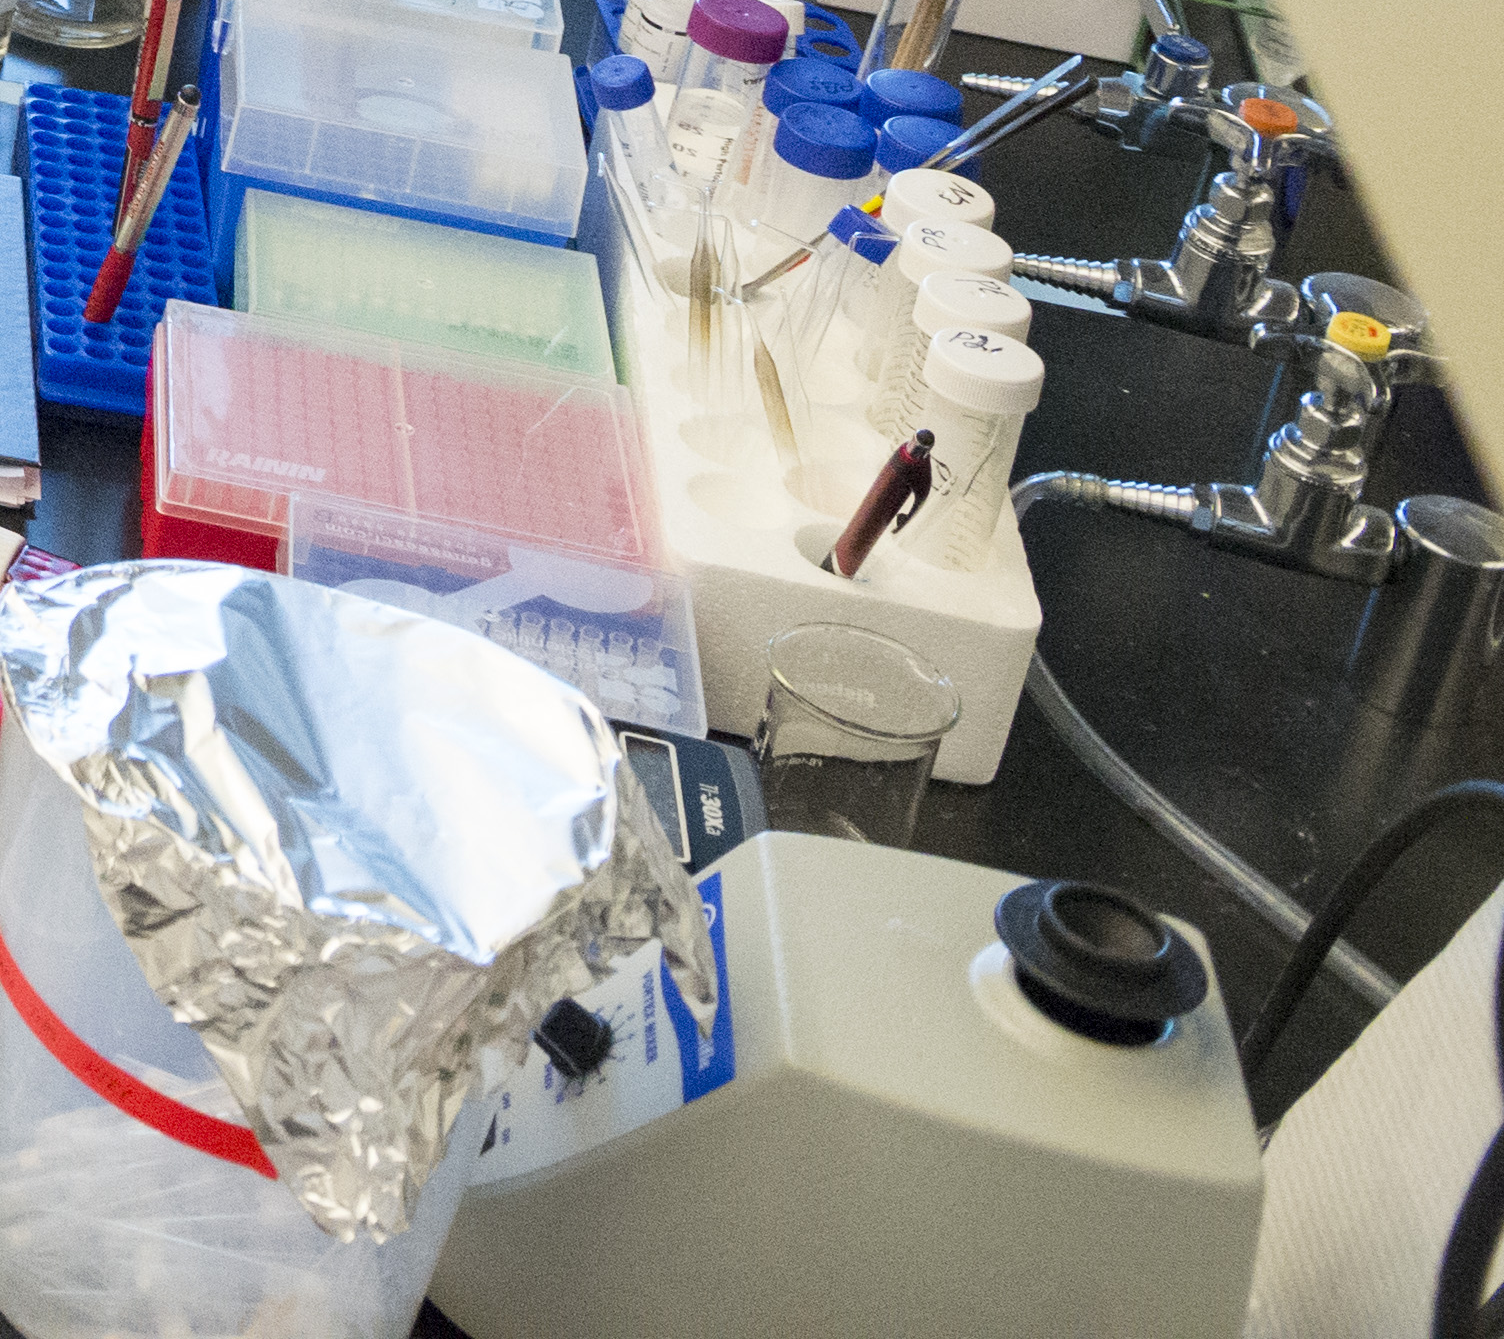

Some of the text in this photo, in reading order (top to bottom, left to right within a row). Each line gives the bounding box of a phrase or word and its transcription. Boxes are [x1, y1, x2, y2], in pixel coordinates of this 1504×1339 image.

[205, 447, 326, 482] RAININ
[698, 783, 725, 837] TI-30Xa
[642, 969, 659, 1066] VORTEX MIXER
